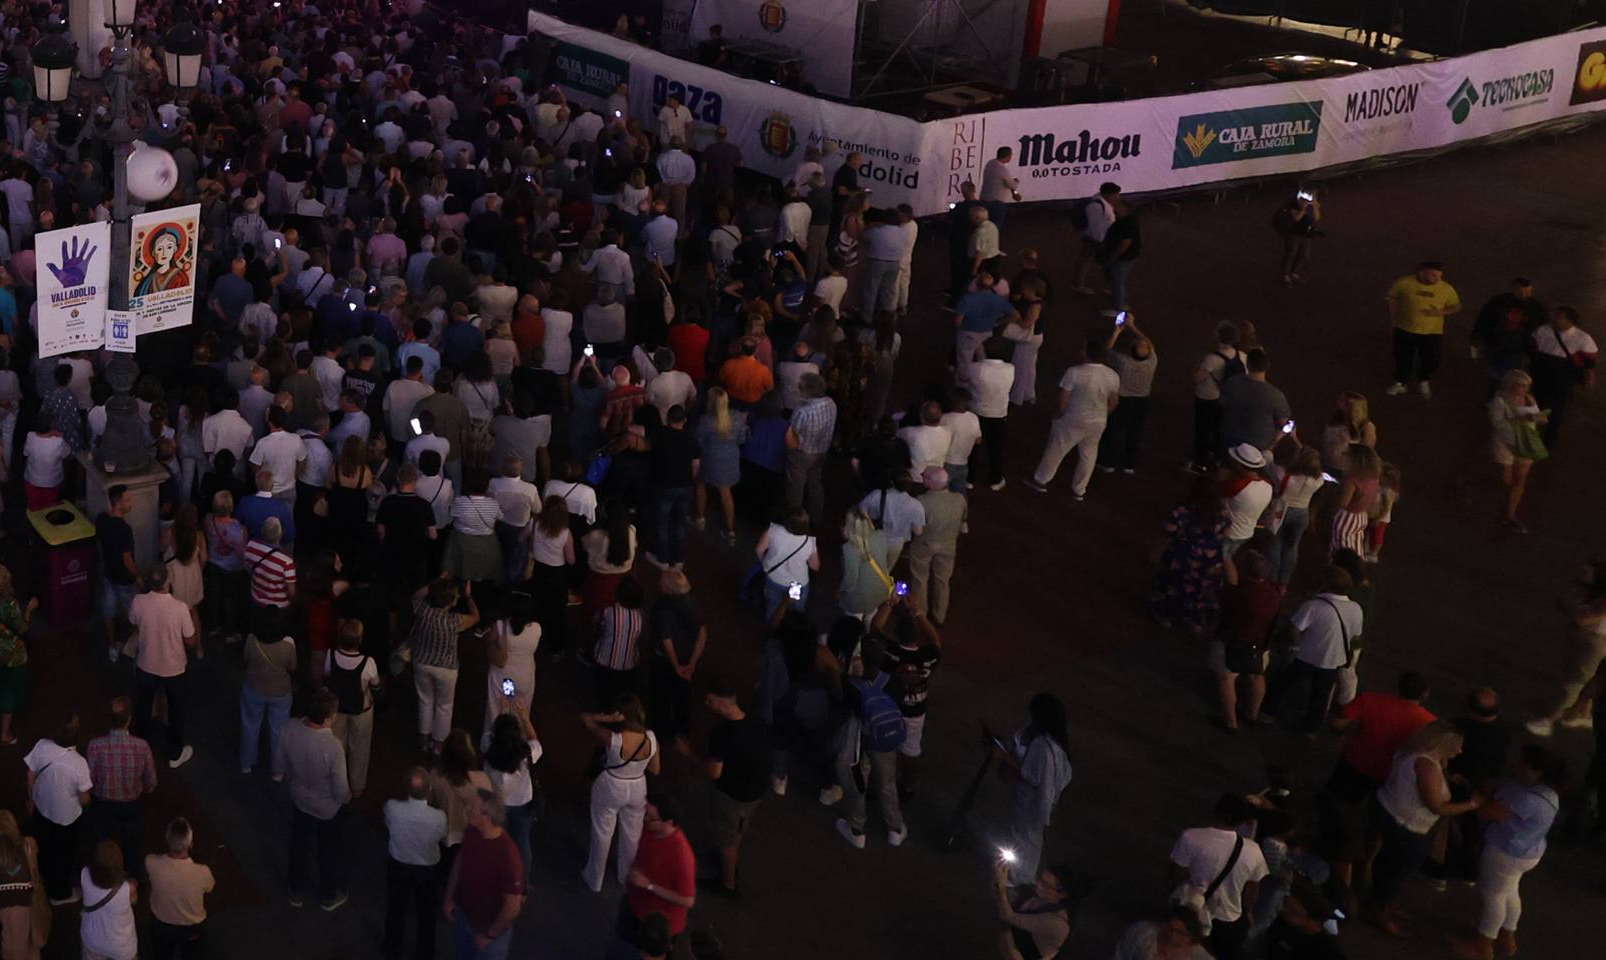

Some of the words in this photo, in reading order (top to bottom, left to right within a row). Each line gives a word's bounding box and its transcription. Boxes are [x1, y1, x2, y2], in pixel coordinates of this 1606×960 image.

[1482, 68, 1554, 108] TECNOCASA
[1345, 83, 1418, 123] MADISON
[1219, 127, 1256, 144] CAJA
[1260, 119, 1313, 139] RURAL
[1233, 141, 1248, 153] DE
[1251, 136, 1295, 151] ZAMORA
[808, 130, 899, 162] Aytamiento
[904, 152, 921, 166] de
[1018, 129, 1141, 167] Mahou
[859, 160, 919, 189] dolid
[51, 286, 96, 303] VALLADOLID
[129, 297, 145, 309] 25
